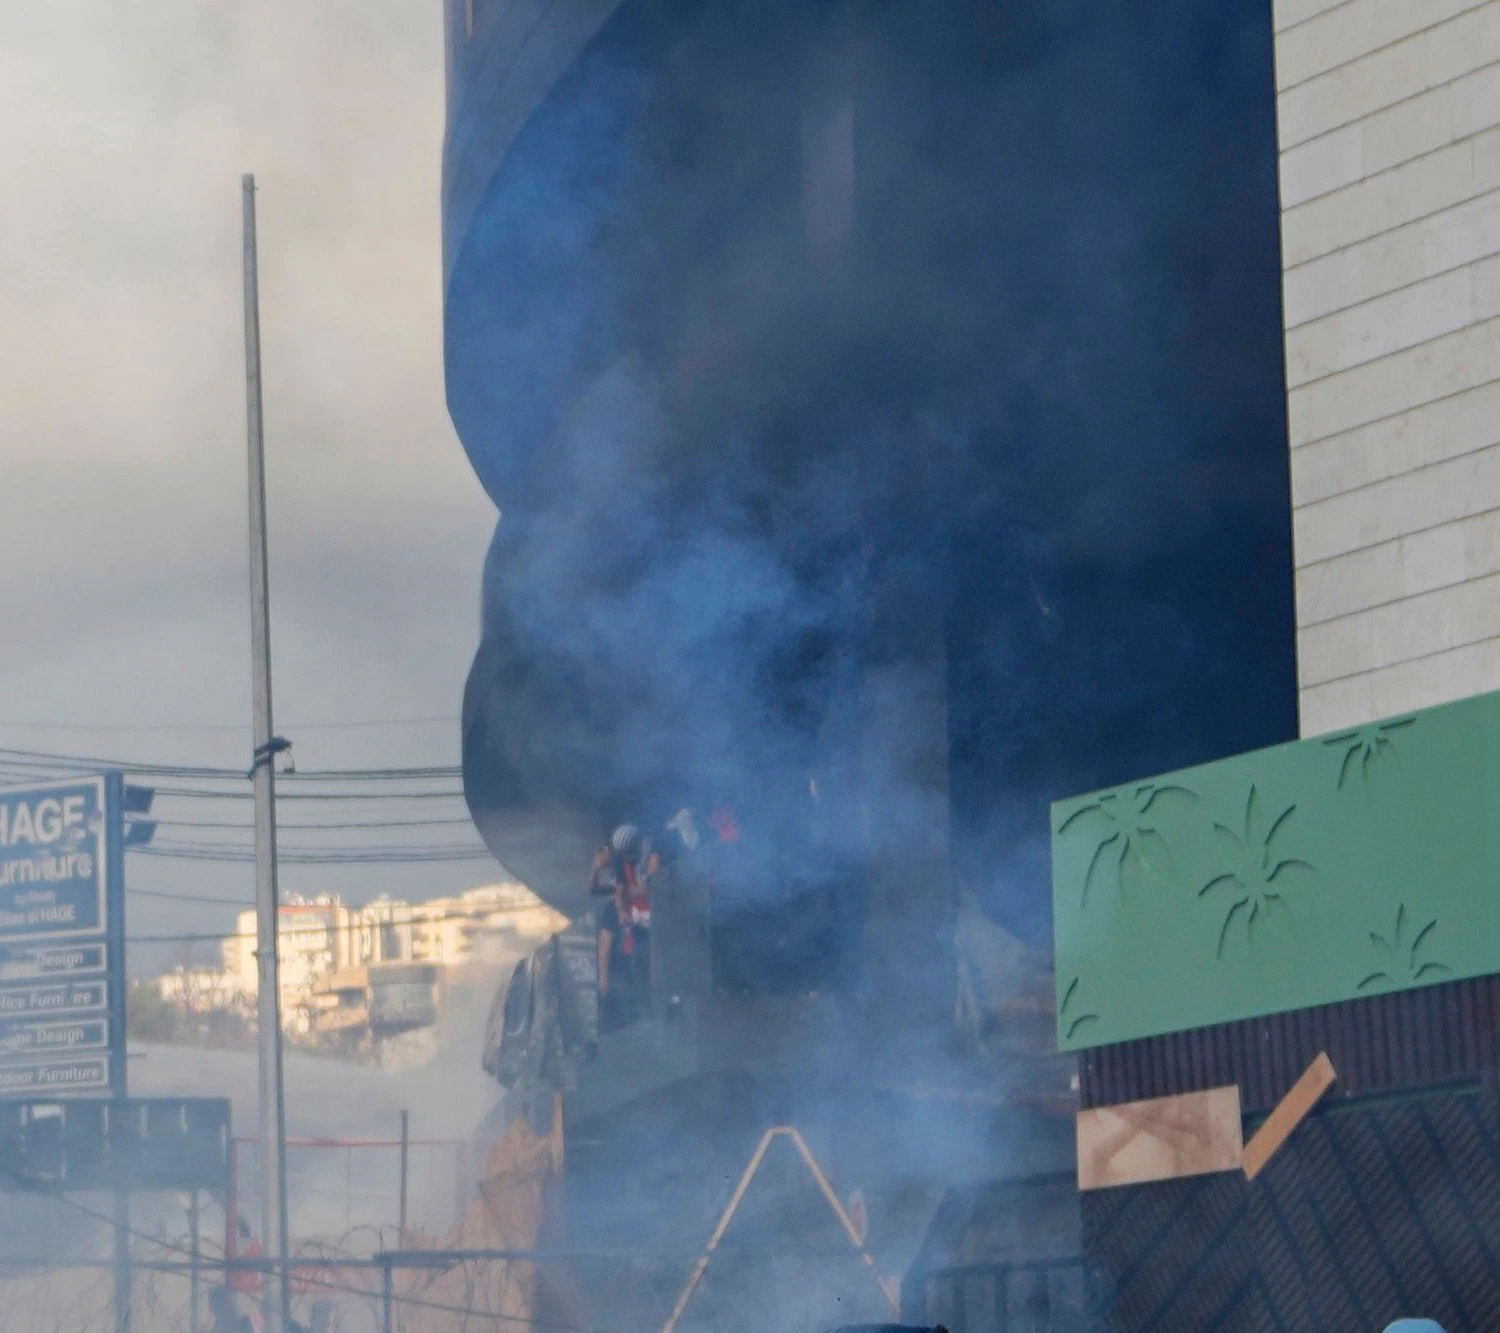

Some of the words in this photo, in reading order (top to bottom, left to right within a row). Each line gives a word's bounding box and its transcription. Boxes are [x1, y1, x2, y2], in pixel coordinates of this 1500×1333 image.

[35, 953, 84, 970] Design
[36, 1028, 85, 1048] Design
[37, 1063, 101, 1084] Furniture
